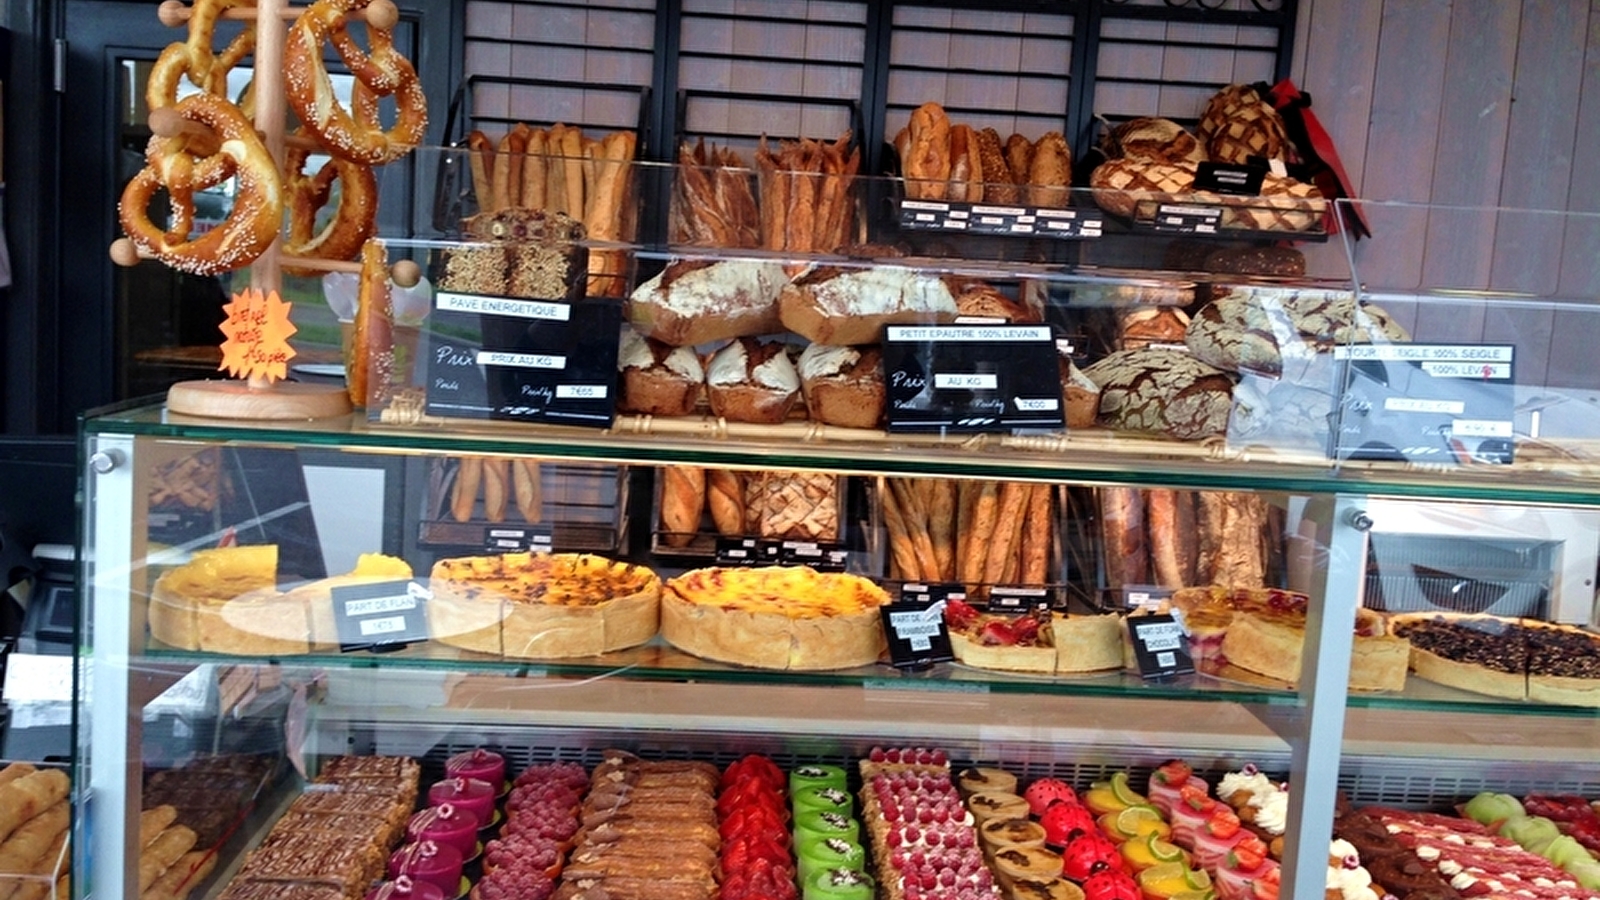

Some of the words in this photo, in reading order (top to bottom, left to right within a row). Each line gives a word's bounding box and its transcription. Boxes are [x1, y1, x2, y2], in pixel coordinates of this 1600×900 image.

[450, 297, 479, 310] PAVE
[481, 300, 558, 317] ENERGETIQUE
[900, 329, 926, 338] PETIT
[929, 329, 975, 338] EPAUTRE
[978, 330, 1001, 338] 100%
[1004, 330, 1039, 338] LEVAIN
[437, 346, 472, 366] Prix
[491, 354, 516, 364] PRIX
[518, 355, 534, 365] AU
[537, 356, 553, 366] KG
[1393, 349, 1429, 358] EIGLE
[1433, 349, 1458, 359] 100%
[1461, 350, 1500, 360] SEIGLE
[1432, 364, 1459, 375] 100%
[892, 370, 926, 388] Prix
[947, 377, 962, 386] AU
[966, 377, 982, 386] KG
[347, 601, 373, 612] PART
[374, 601, 388, 610] DE
[389, 598, 415, 608] FLAN
